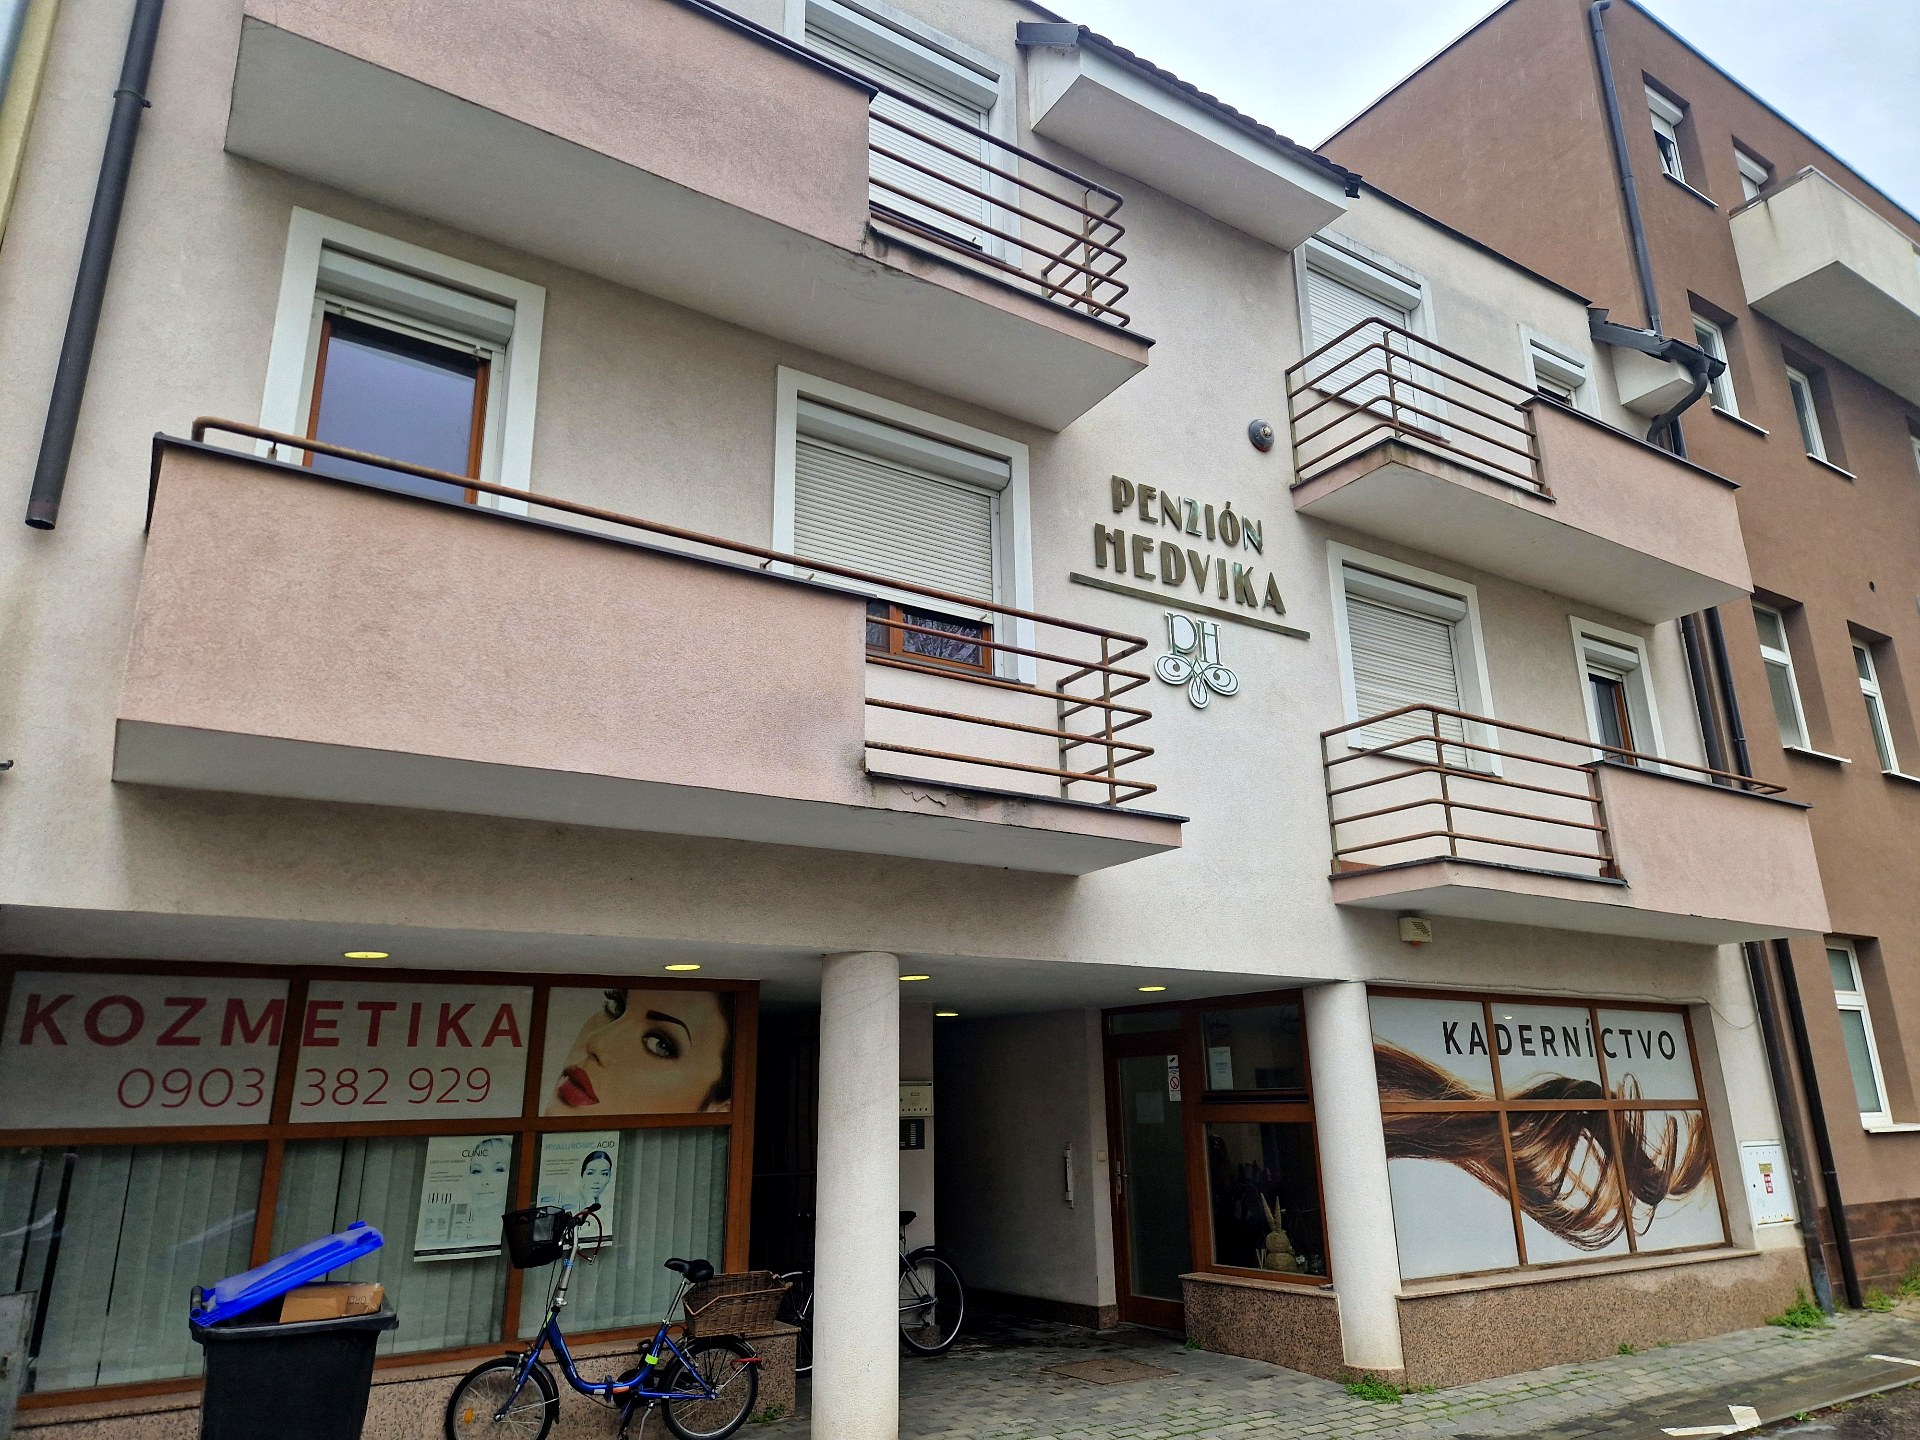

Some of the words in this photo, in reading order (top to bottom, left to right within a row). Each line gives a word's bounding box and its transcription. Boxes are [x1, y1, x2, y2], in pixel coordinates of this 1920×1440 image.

[1111, 474, 1264, 556] PENZIÓN
[1094, 522, 1287, 615] HEDVIKA
[1164, 610, 1222, 666] PH
[18, 993, 524, 1050] KOZMETIKA
[1442, 1018, 1677, 1061] KADERNÍCTVO
[116, 1067, 266, 1110] 0903
[299, 1067, 390, 1107] 382
[406, 1066, 492, 1105] 929
[461, 1149, 489, 1158] CLINIC
[597, 1140, 615, 1149] ACID
